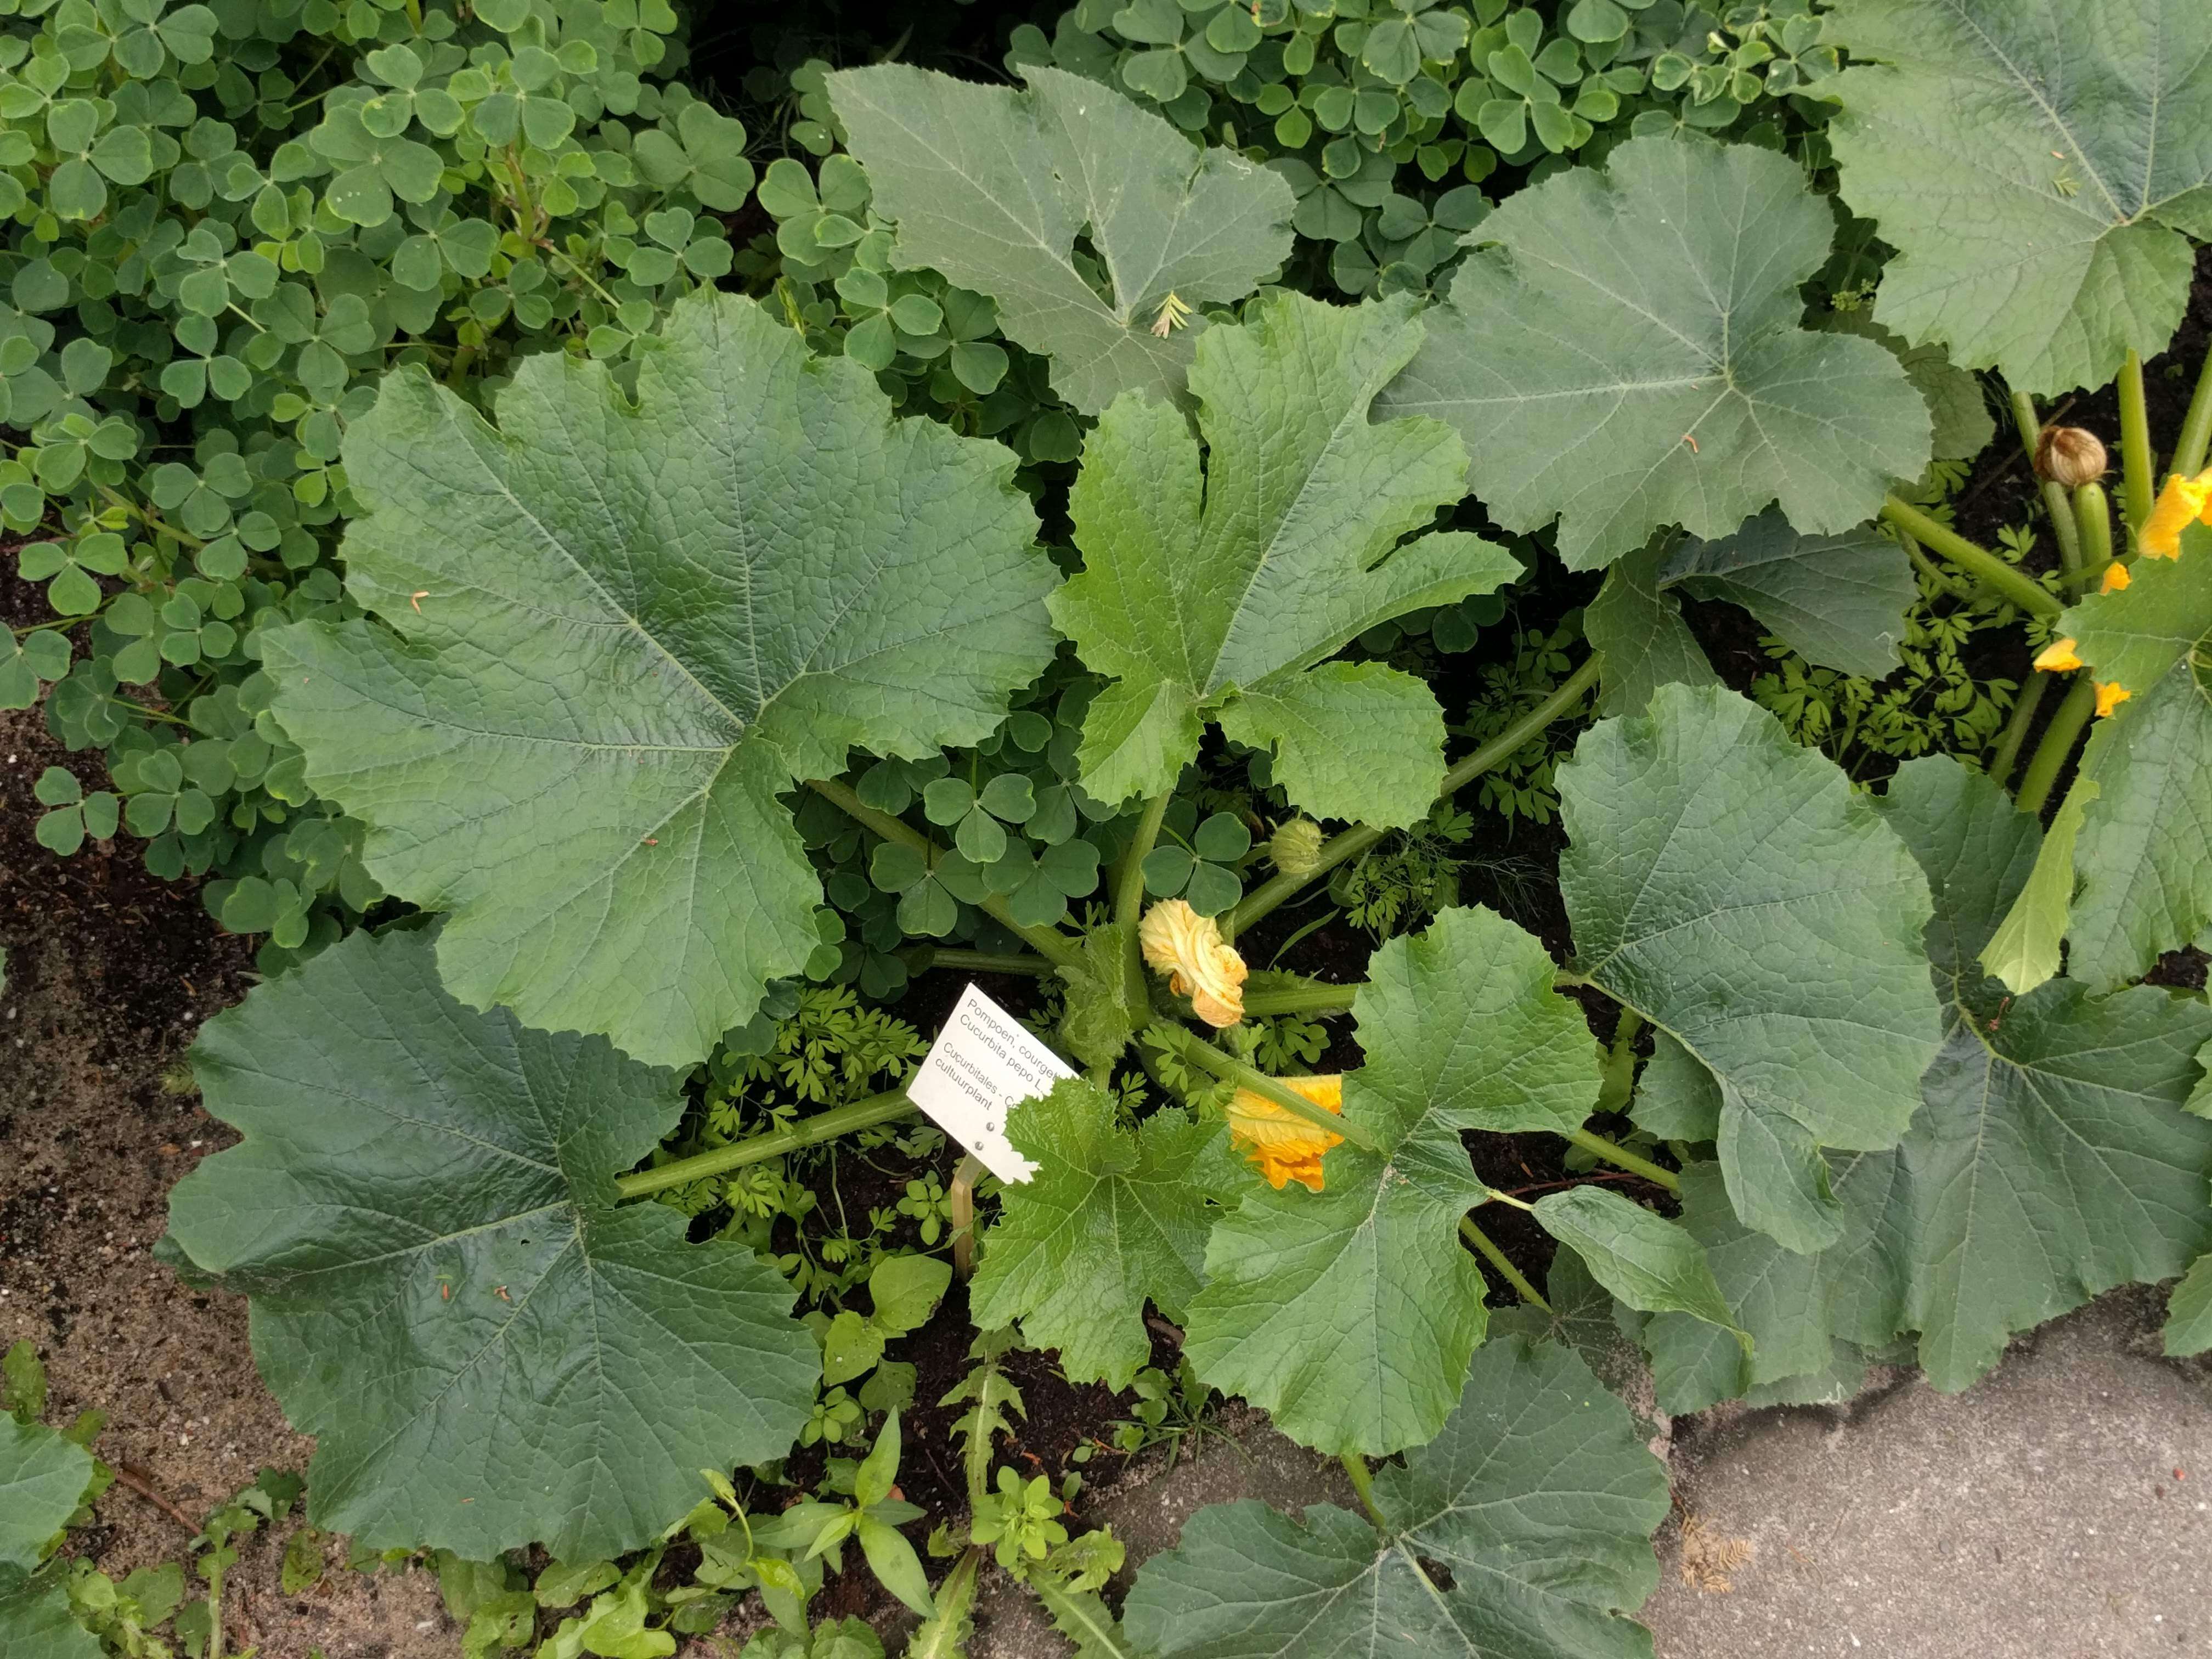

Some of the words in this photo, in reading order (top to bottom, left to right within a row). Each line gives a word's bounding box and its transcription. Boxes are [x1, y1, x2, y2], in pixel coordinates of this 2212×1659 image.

[968, 998, 1015, 1047] Pompoen,
[944, 1042, 997, 1093] Cucurbitales
[960, 1014, 1006, 1059] Cucurbita
[1007, 1057, 1033, 1082] pepo
[1034, 1078, 1043, 1092] L.
[935, 1059, 992, 1110] cultuurplant
